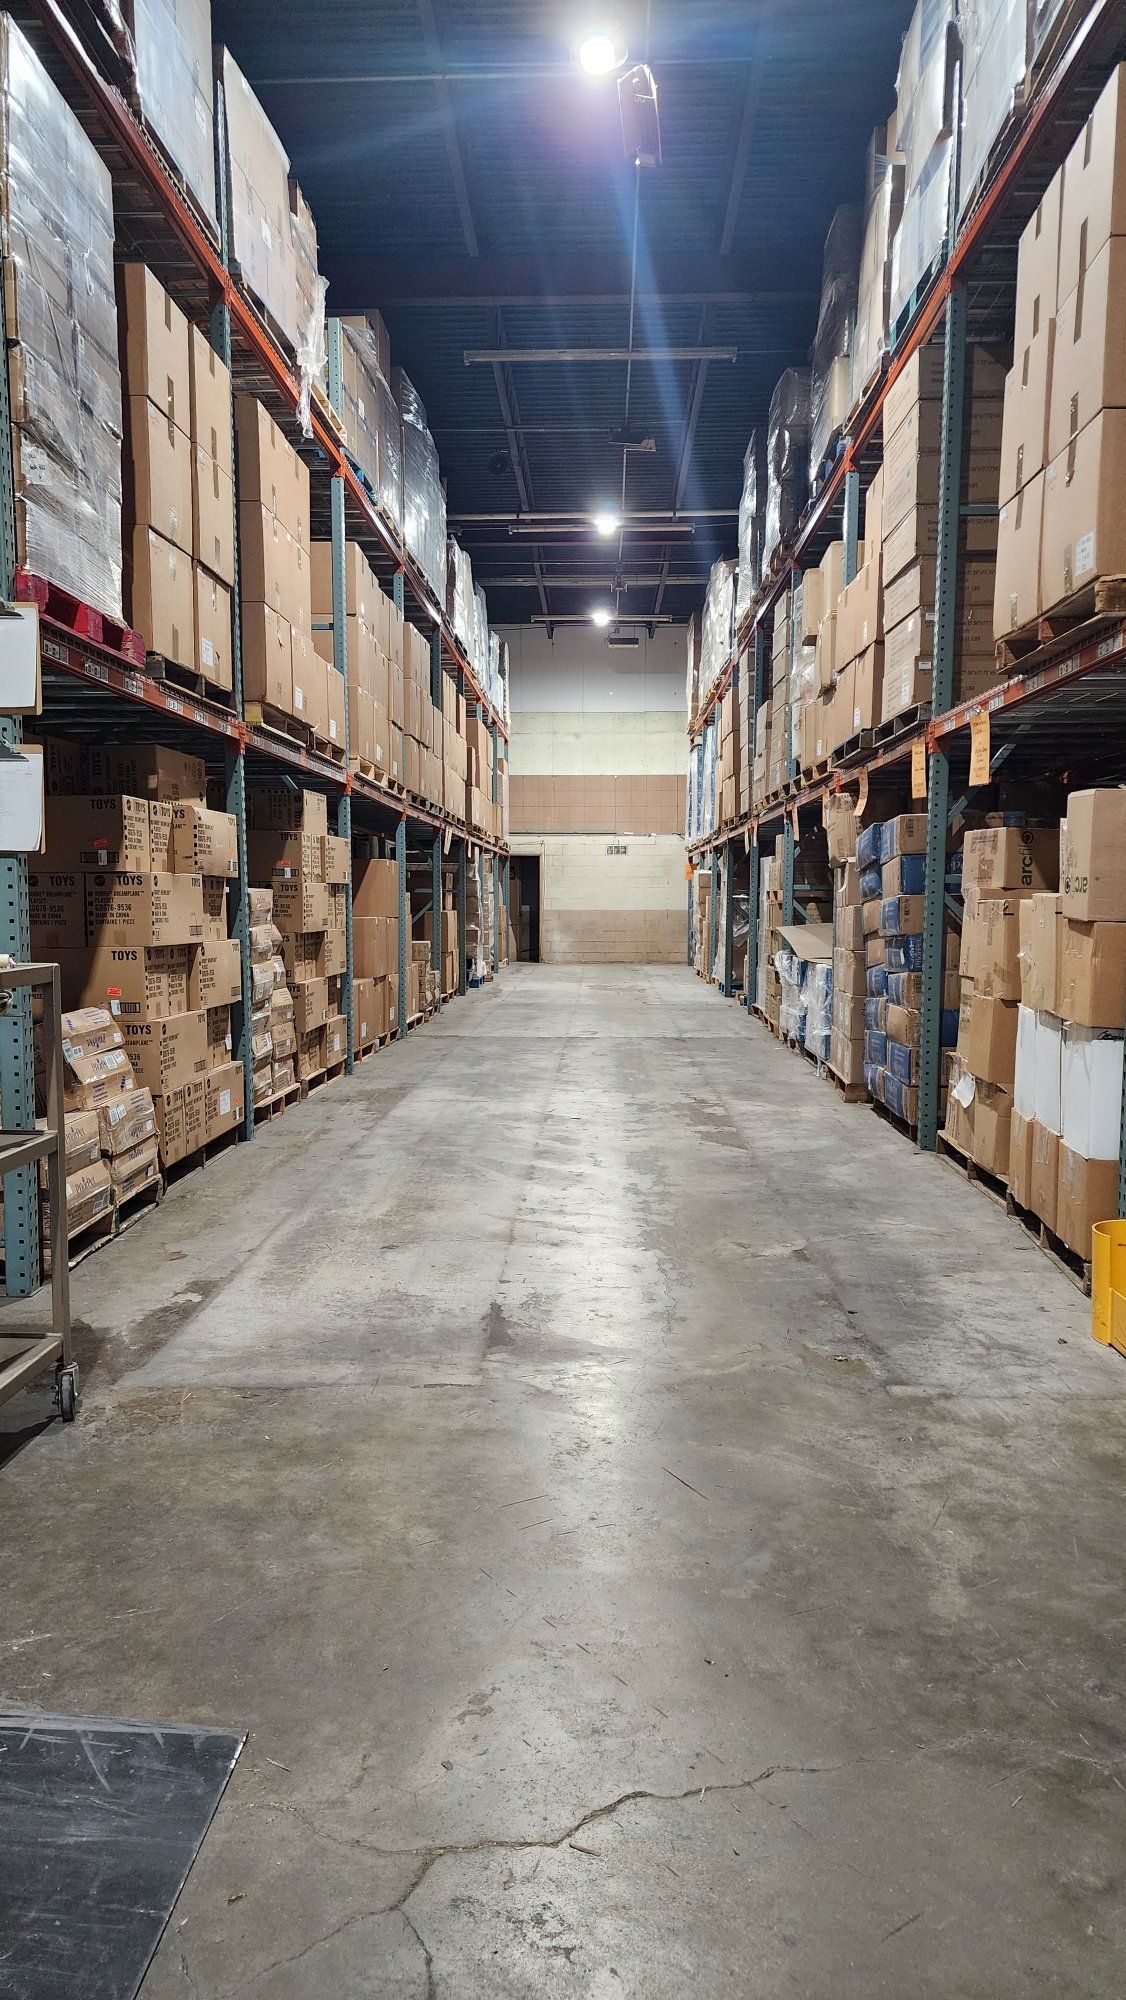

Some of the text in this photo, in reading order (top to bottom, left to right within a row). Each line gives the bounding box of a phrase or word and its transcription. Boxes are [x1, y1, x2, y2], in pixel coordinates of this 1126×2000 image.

[90, 799, 116, 809] TOYS
[173, 809, 186, 819] YS
[49, 875, 75, 887] TOYS
[116, 875, 143, 886] TOYS
[280, 884, 298, 892] TOYS
[111, 950, 138, 960] TOYS
[125, 1025, 152, 1035] TOYS
